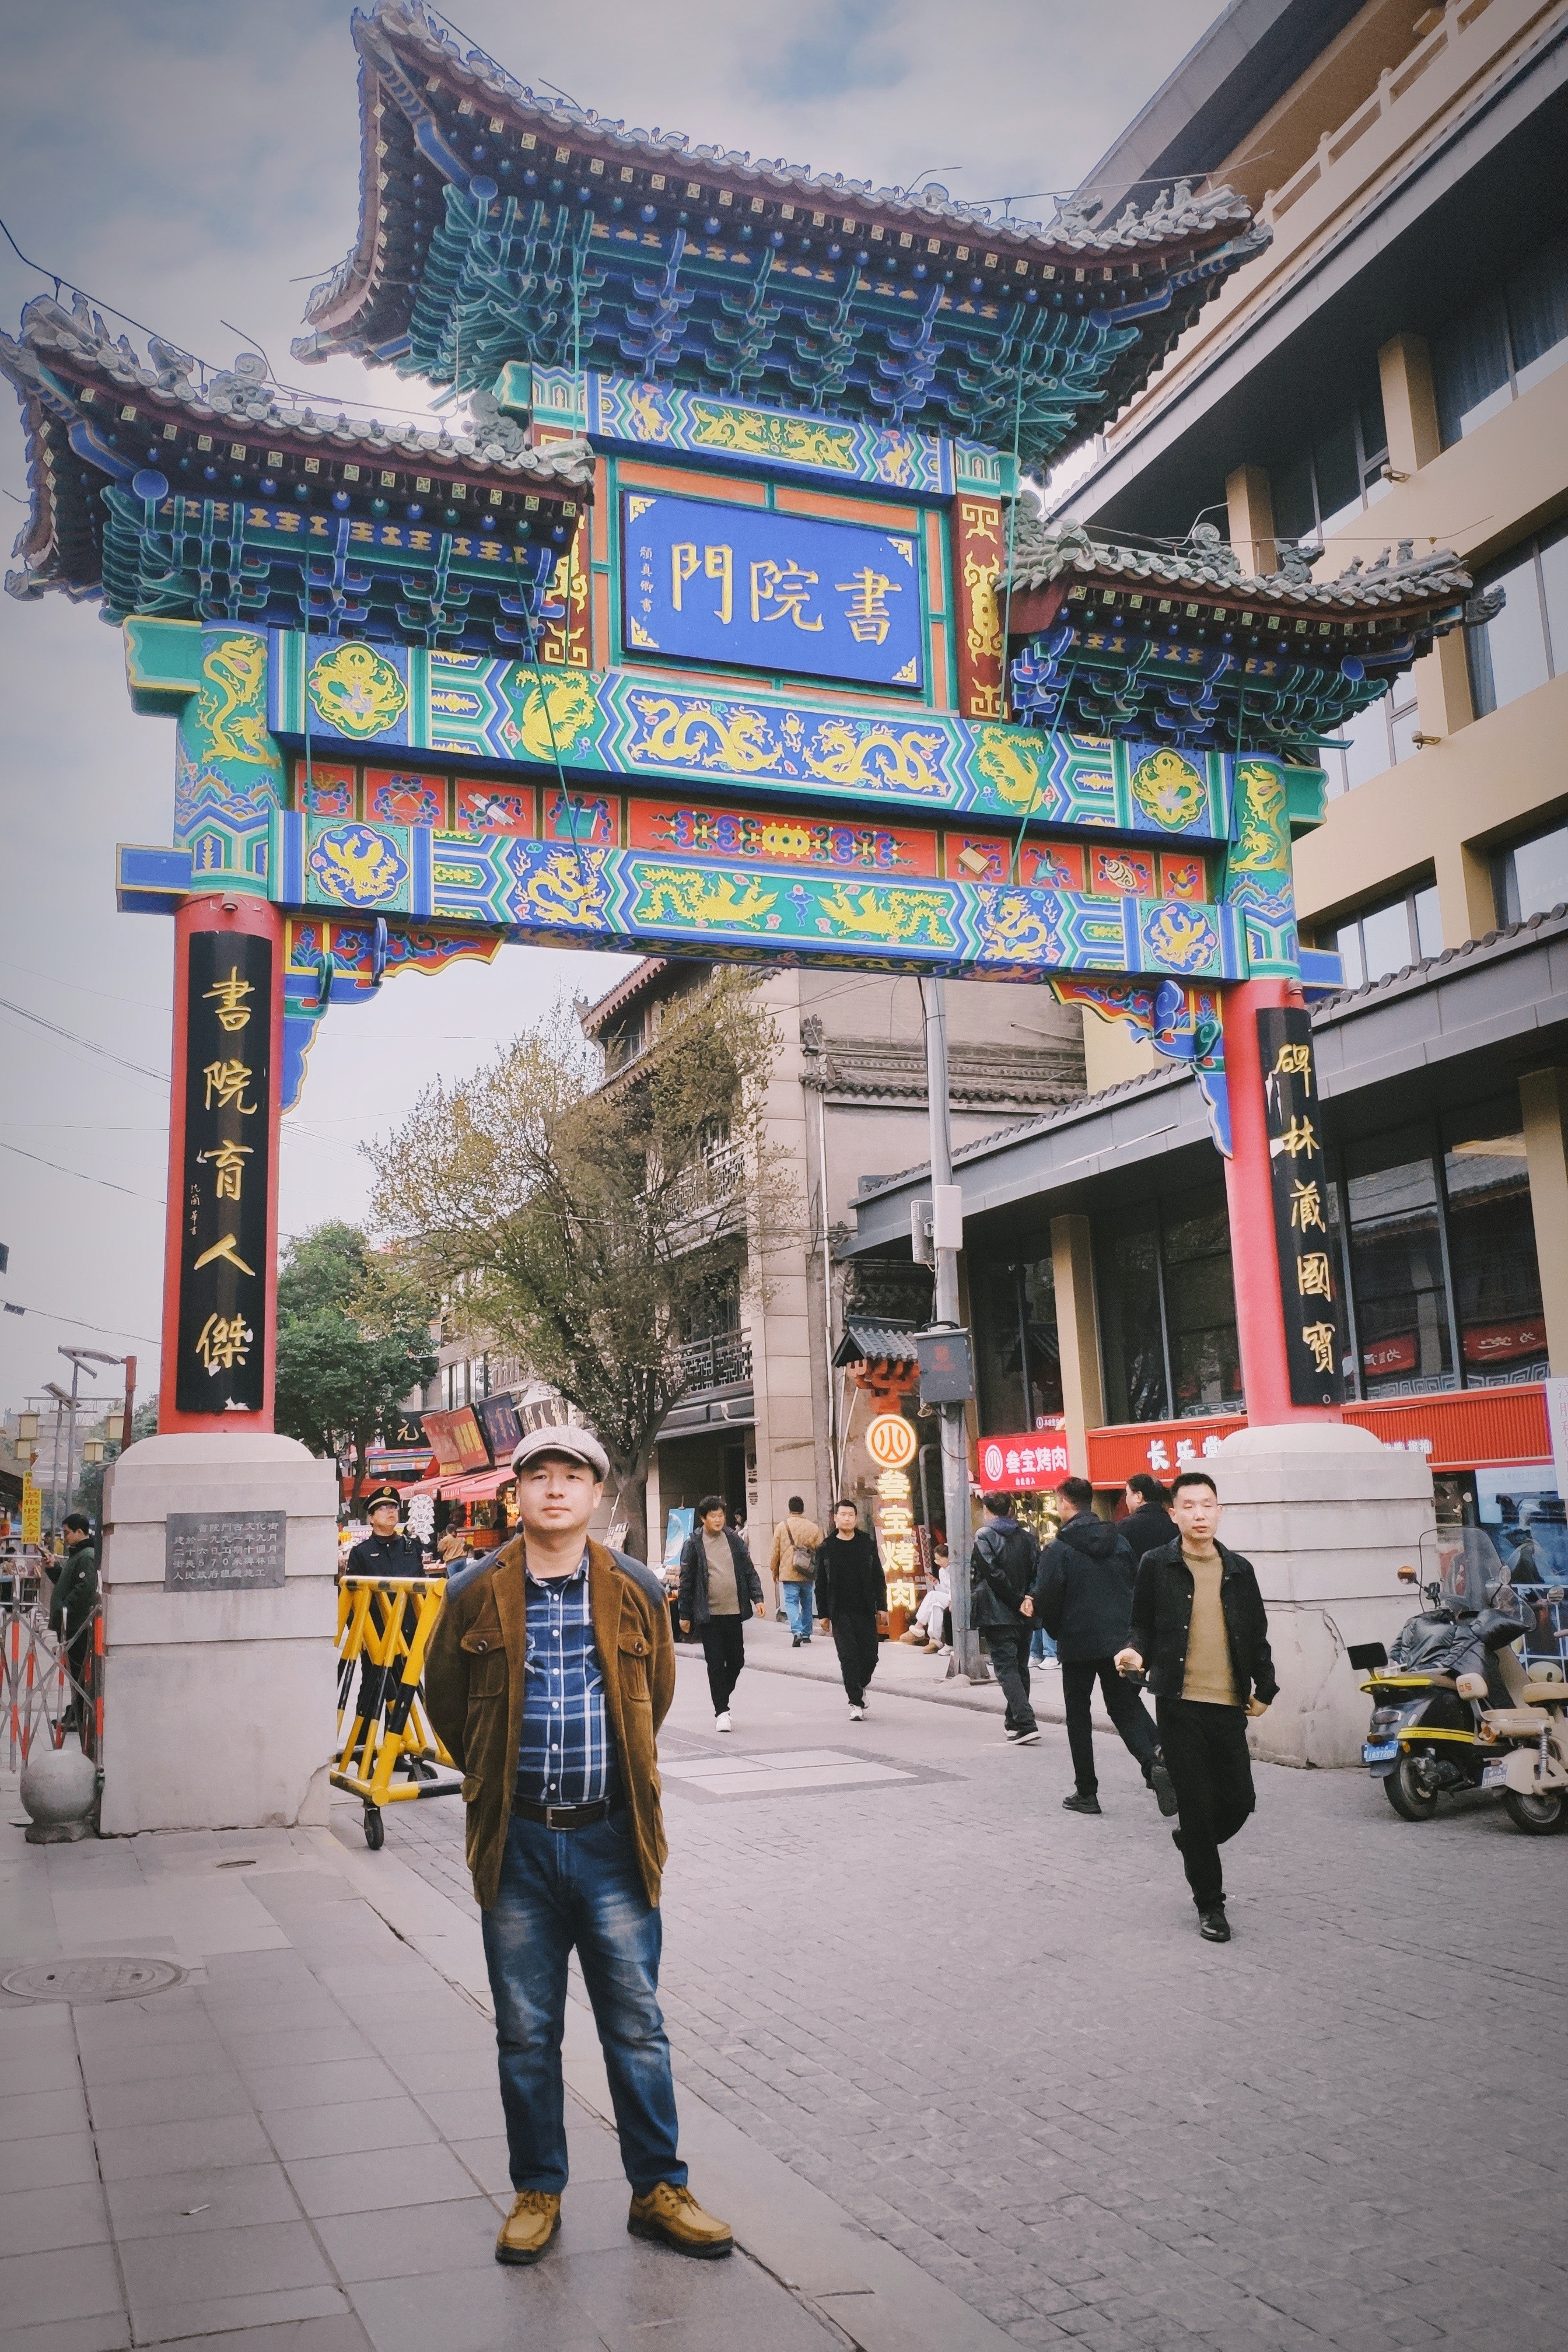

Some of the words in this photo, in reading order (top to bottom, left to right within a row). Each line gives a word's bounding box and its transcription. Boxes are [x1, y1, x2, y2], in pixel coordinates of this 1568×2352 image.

[193, 965, 257, 1370] 書院育人傑
[1005, 1445, 1068, 1475] 叁宝烤肉
[877, 1469, 917, 1612] 叁宝烤肉
